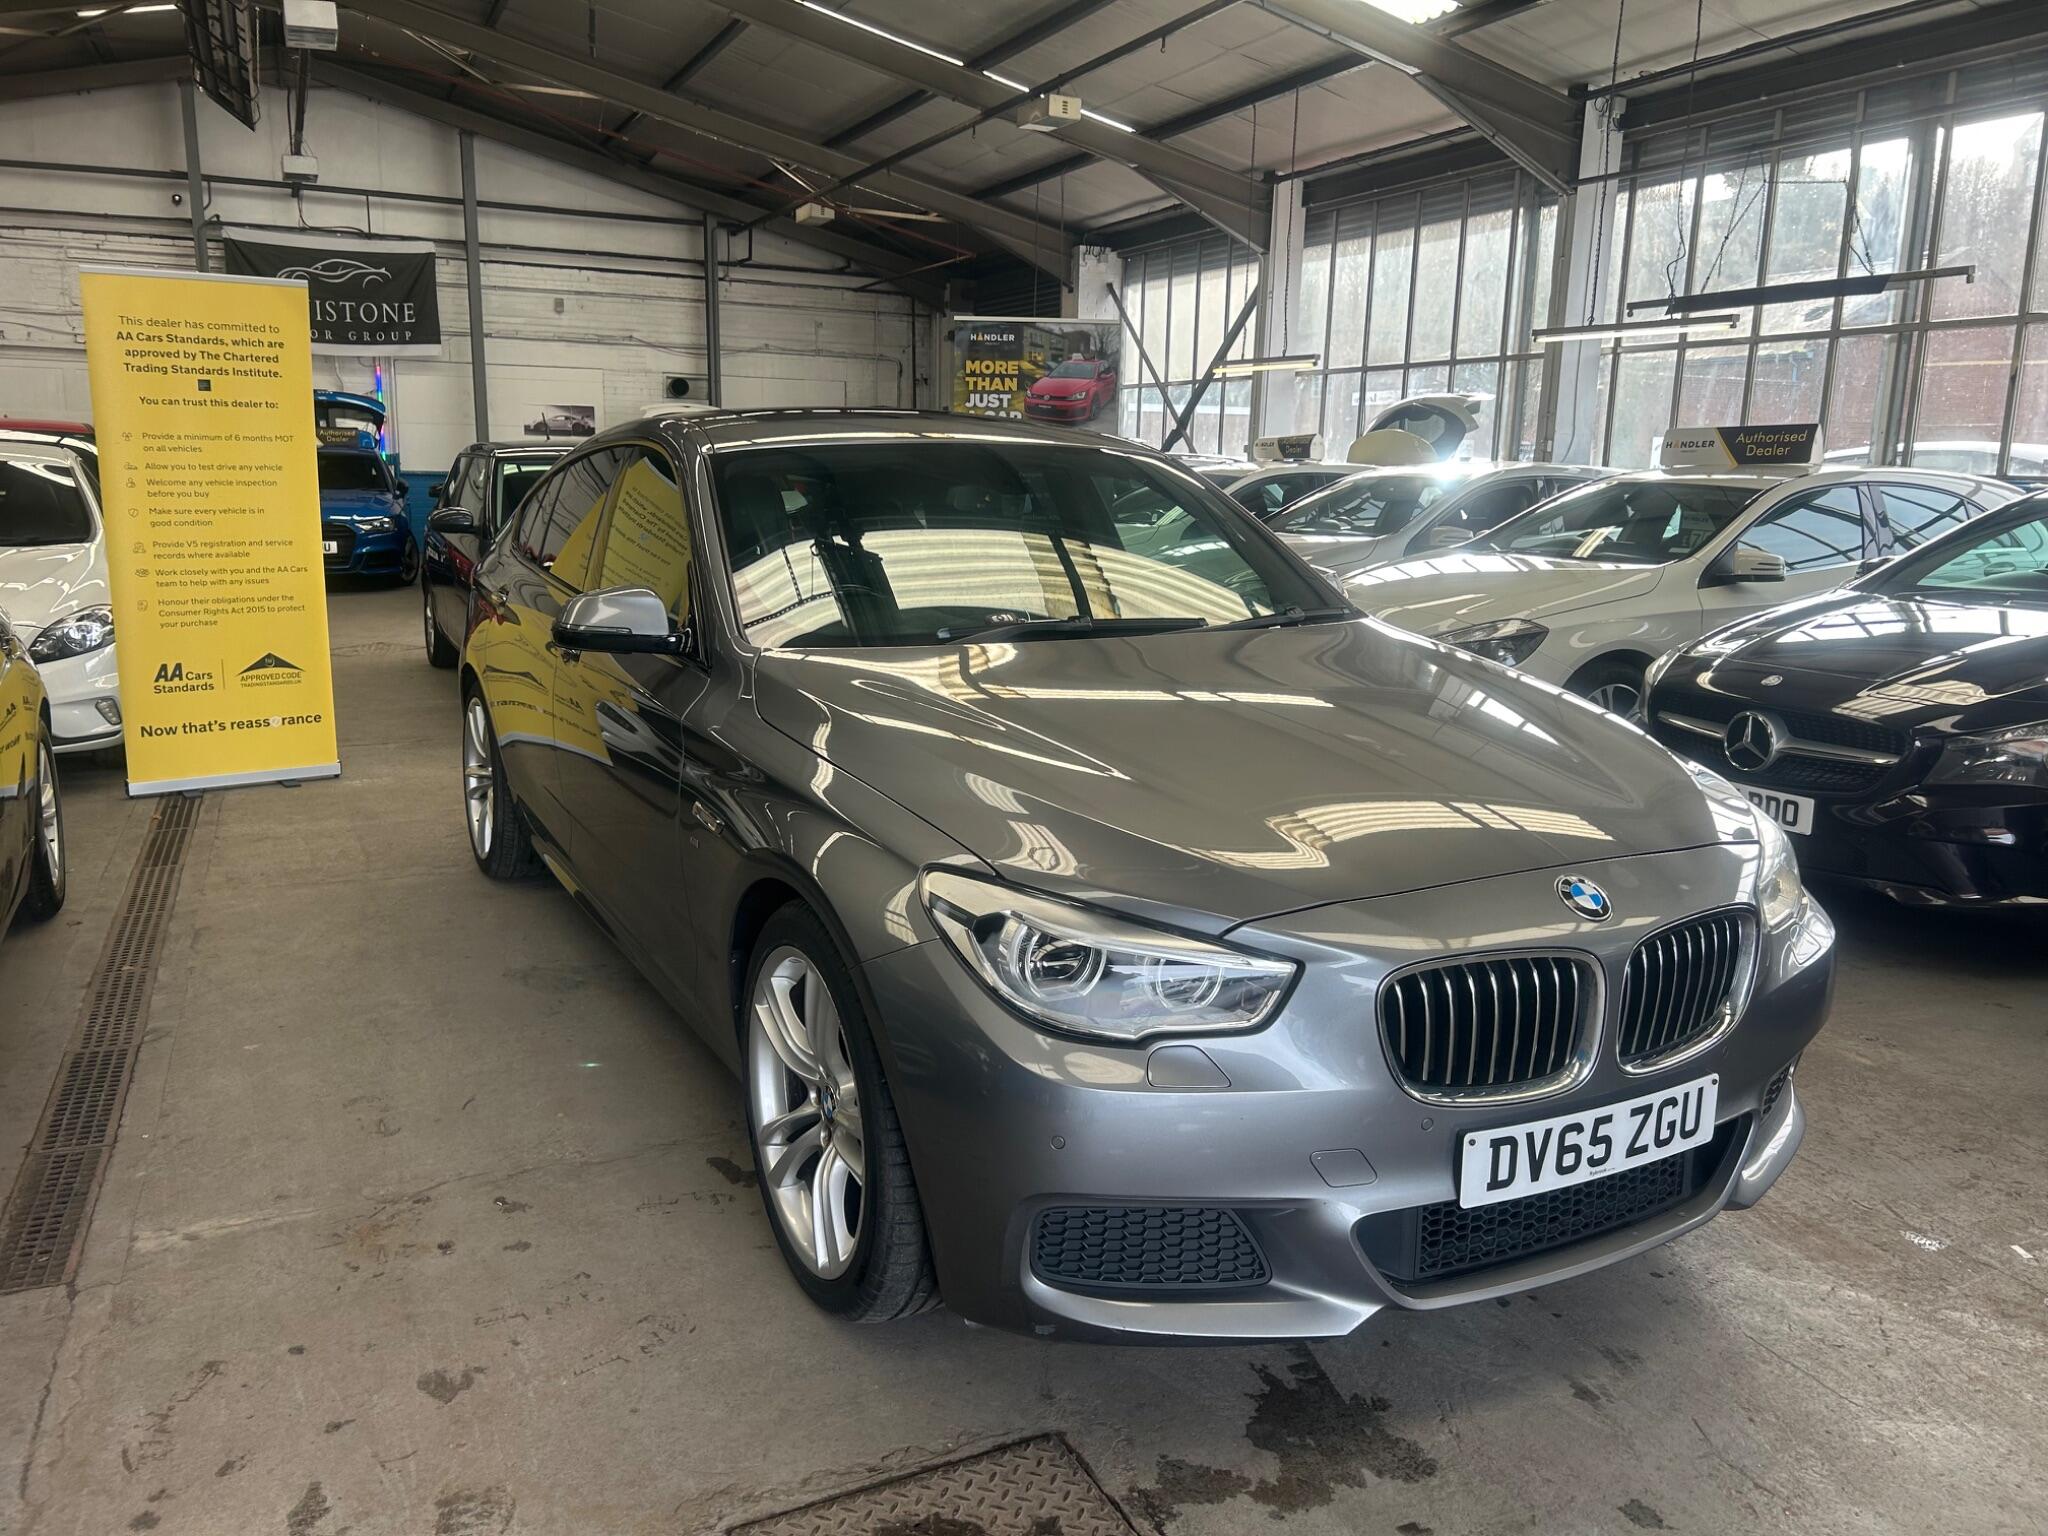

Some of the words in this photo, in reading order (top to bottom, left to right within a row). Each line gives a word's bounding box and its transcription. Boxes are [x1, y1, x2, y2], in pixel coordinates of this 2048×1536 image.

[313, 299, 416, 323] ISTONE
[118, 315, 143, 326] This
[146, 318, 182, 328] dealer
[184, 320, 204, 330] has
[207, 322, 266, 333] committed
[269, 324, 280, 334] to
[116, 332, 133, 341] AA
[136, 333, 163, 343] Cars
[167, 334, 229, 347] Standards,
[231, 338, 264, 348] which
[267, 340, 284, 349] are
[348, 330, 412, 341] GROUP
[125, 349, 180, 360] approved
[183, 350, 196, 361] by
[200, 351, 221, 360] The
[223, 352, 279, 363] Chartered
[124, 363, 168, 375] Trading
[171, 365, 230, 376] Standards
[232, 368, 282, 378] Institute.
[965, 360, 1019, 375] MORE
[965, 377, 1018, 391] THAN
[139, 396, 159, 405] You
[182, 398, 207, 407] trust
[210, 399, 228, 407] this
[231, 400, 263, 409] dealer
[265, 401, 278, 409] to:
[965, 393, 1012, 408] JUST
[142, 432, 174, 441] Provide
[184, 433, 222, 441] minimum
[224, 433, 233, 441] of
[235, 434, 241, 442] 6
[243, 434, 273, 442] months
[275, 435, 294, 443] MOT
[319, 429, 356, 437] Authorised
[1735, 430, 1808, 444] Authorised
[1746, 445, 1791, 457] Dealer
[171, 464, 186, 472] you
[147, 479, 186, 487] Welcome
[205, 479, 233, 487] vehicle
[235, 479, 277, 488] inspection
[149, 507, 171, 515] Make
[195, 508, 217, 516] every
[219, 507, 247, 515] vehicle
[150, 519, 171, 528] good
[174, 519, 212, 527] condition
[186, 540, 198, 548] V5
[200, 539, 246, 549] registration
[249, 539, 263, 547] and
[265, 539, 293, 547] service
[188, 551, 212, 559] where
[215, 550, 250, 559] available
[155, 568, 178, 576] Work
[180, 567, 208, 577] closely
[211, 567, 227, 575] with
[229, 568, 244, 576] you
[190, 578, 207, 588] help
[210, 578, 227, 586] with
[229, 579, 243, 587] any
[245, 577, 269, 585] issues
[158, 598, 188, 606] Honour
[191, 597, 209, 605] their
[212, 596, 255, 605] obligations
[258, 595, 280, 603] under
[282, 594, 294, 602] the
[159, 608, 201, 617] Consumer
[204, 607, 229, 617] Rights
[231, 606, 244, 614] Act
[246, 605, 265, 614] 2015
[267, 605, 275, 613] to
[277, 604, 305, 613] protect
[160, 620, 178, 629] your
[180, 619, 218, 628] purchase
[154, 663, 182, 682] AA
[186, 672, 212, 681] Cars
[240, 672, 280, 682] APPROVED
[281, 671, 302, 680] CODE
[154, 682, 214, 694] Standards
[141, 725, 178, 737] Now
[182, 720, 226, 734] that's
[231, 713, 321, 730] reassrance
[1486, 1114, 1614, 1193] DV65
[1625, 1086, 1704, 1160] ZGU
